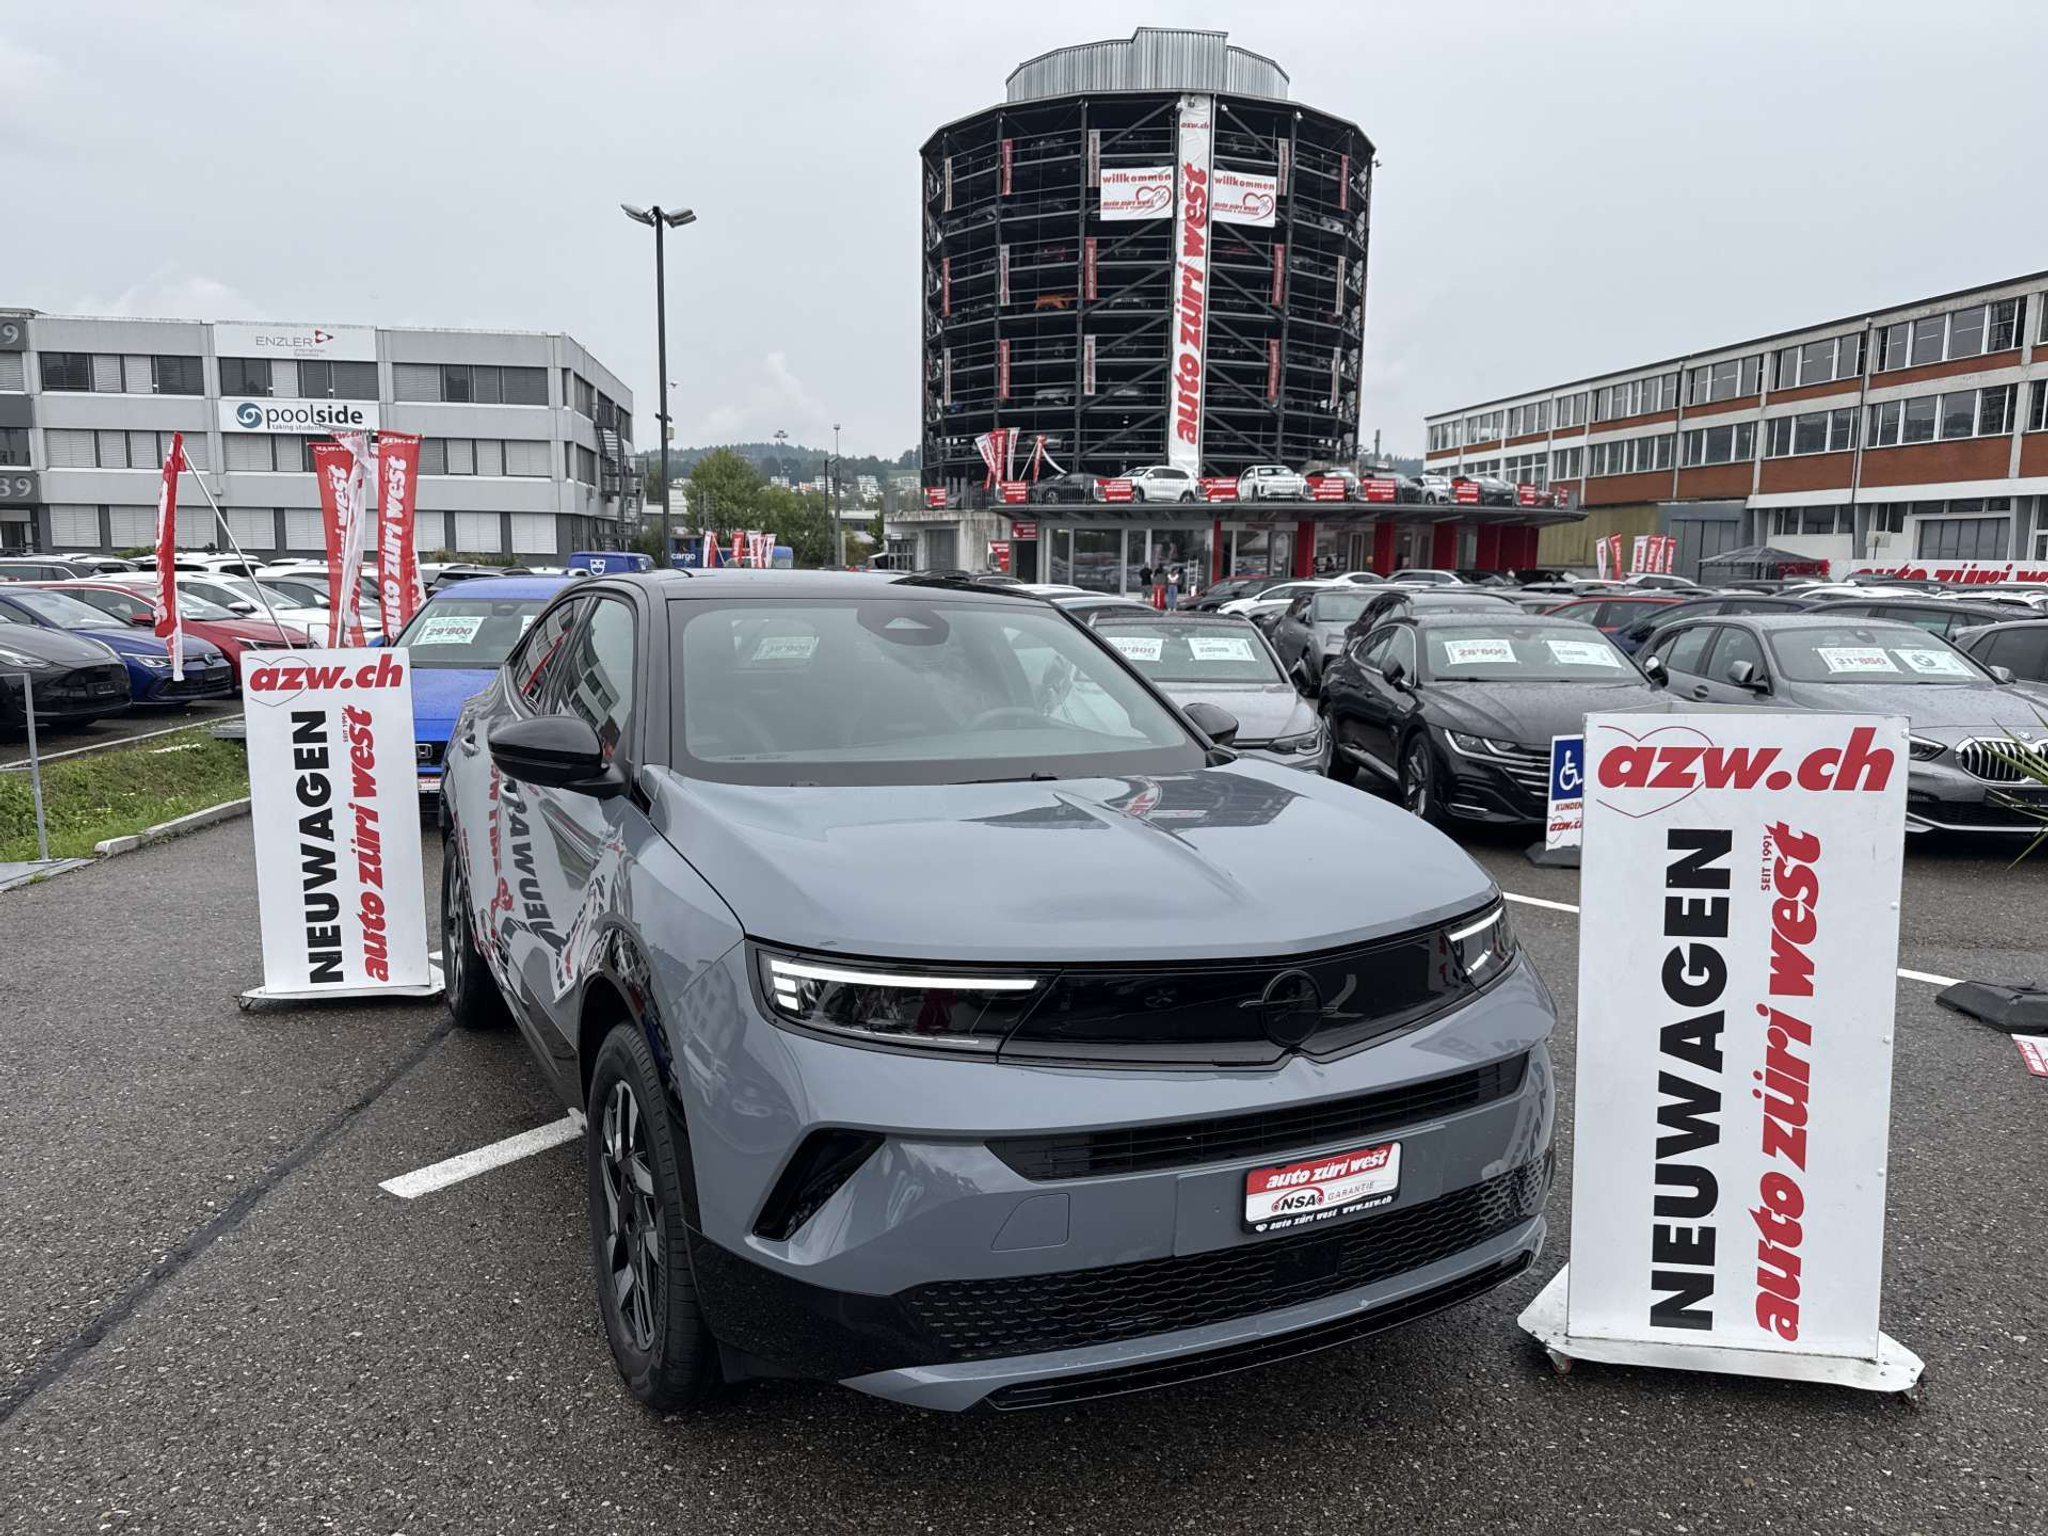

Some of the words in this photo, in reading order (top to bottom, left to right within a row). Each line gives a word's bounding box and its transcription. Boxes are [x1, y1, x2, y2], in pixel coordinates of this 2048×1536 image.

[1102, 173, 1172, 184] willkommen
[1183, 162, 1209, 259] west
[1213, 176, 1275, 190] willkommen
[1176, 260, 1205, 347] züri
[255, 335, 313, 348] ENZLER
[265, 404, 364, 430] poolside
[1175, 352, 1200, 446] auto
[386, 454, 407, 519] west
[382, 519, 404, 575] züri
[670, 551, 697, 562] cargo
[250, 653, 403, 692] azw.ch
[347, 704, 377, 798] west
[1597, 727, 1895, 792] azw.ch
[290, 711, 344, 984] NEUWAGEN
[347, 801, 384, 890] züri
[1761, 864, 1771, 891] SEIT
[1763, 835, 1772, 862] 1991
[356, 890, 389, 983] auto
[1764, 821, 1821, 997] west
[1650, 828, 1733, 1331] NEUWAGEN
[1751, 1003, 1812, 1172] züri
[1266, 1169, 1310, 1189] auto
[1310, 1158, 1351, 1182] züri
[1350, 1149, 1389, 1173] west
[1280, 1195, 1317, 1211] NSA
[1328, 1181, 1375, 1201] GARANTIE
[1269, 1220, 1292, 1230] auto
[1293, 1214, 1315, 1226] züri
[1317, 1209, 1338, 1221] west
[1342, 1195, 1393, 1215] www.azw.ch
[1748, 1171, 1805, 1342] auto
